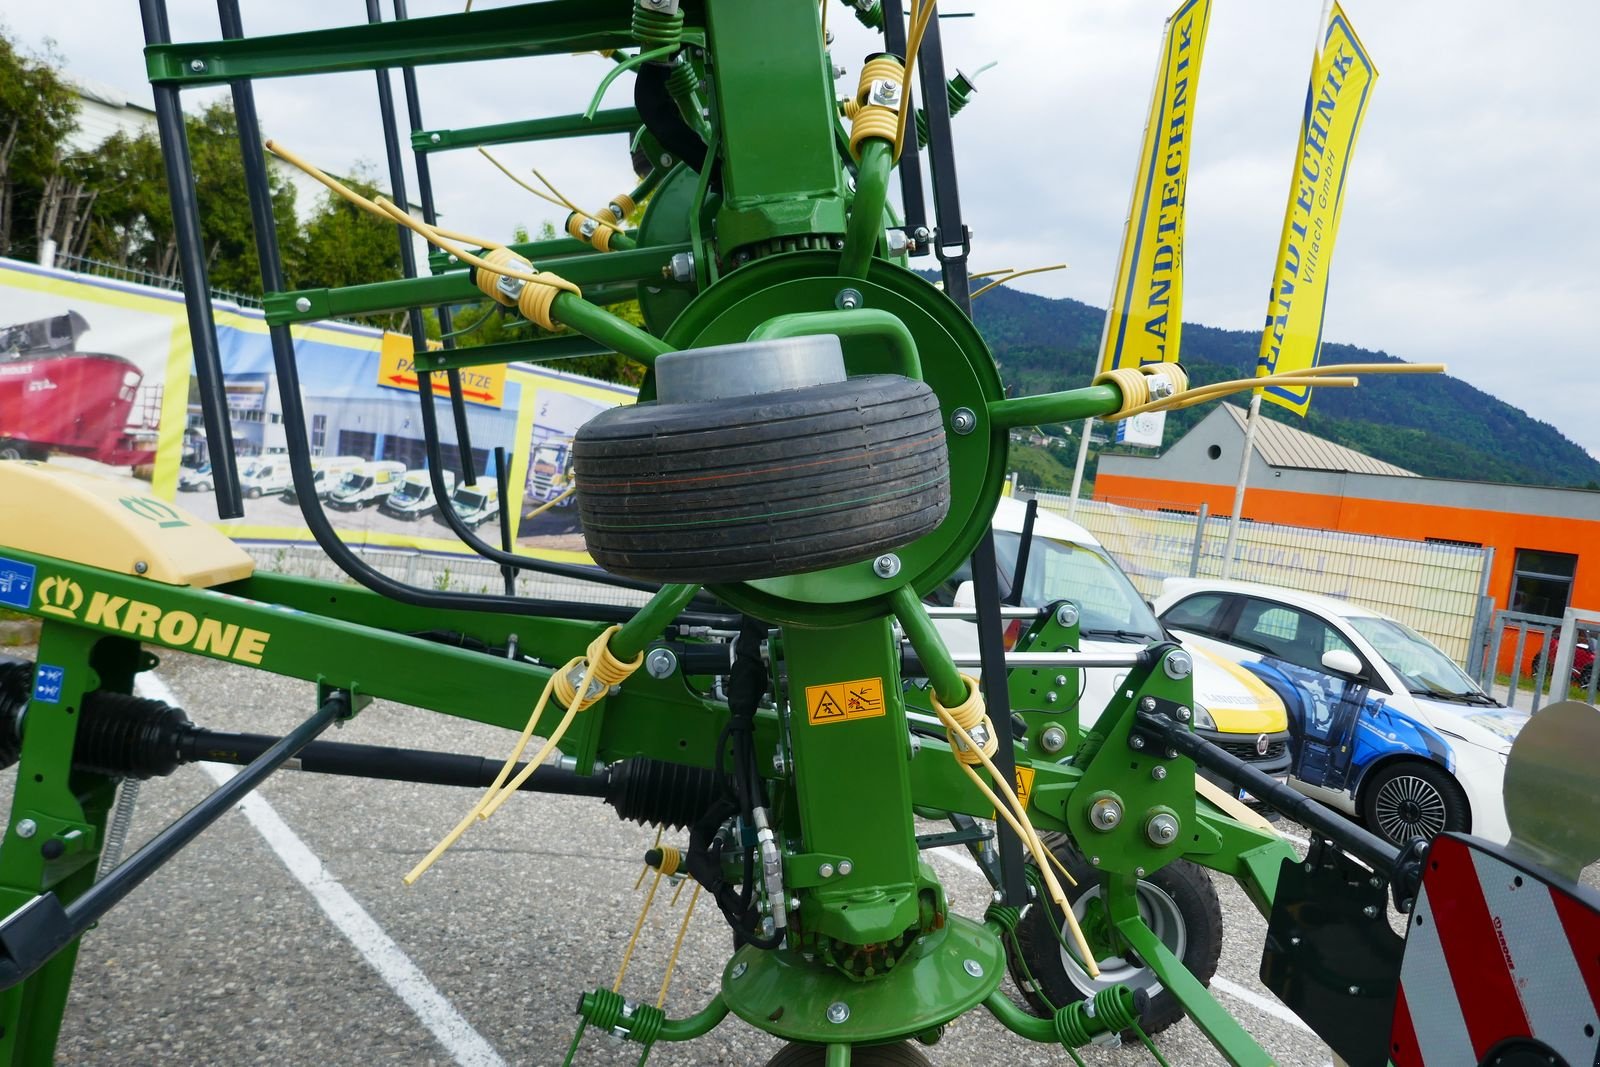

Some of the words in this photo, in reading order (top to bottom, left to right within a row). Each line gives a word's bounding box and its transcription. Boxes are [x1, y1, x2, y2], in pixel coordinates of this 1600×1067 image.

[1140, 12, 1193, 367] LANDTECHNIK
[1303, 217, 1324, 284] Villach
[1318, 149, 1335, 209] GmbH
[84, 591, 271, 664] KRONE
[1497, 930, 1515, 970] KRONE
